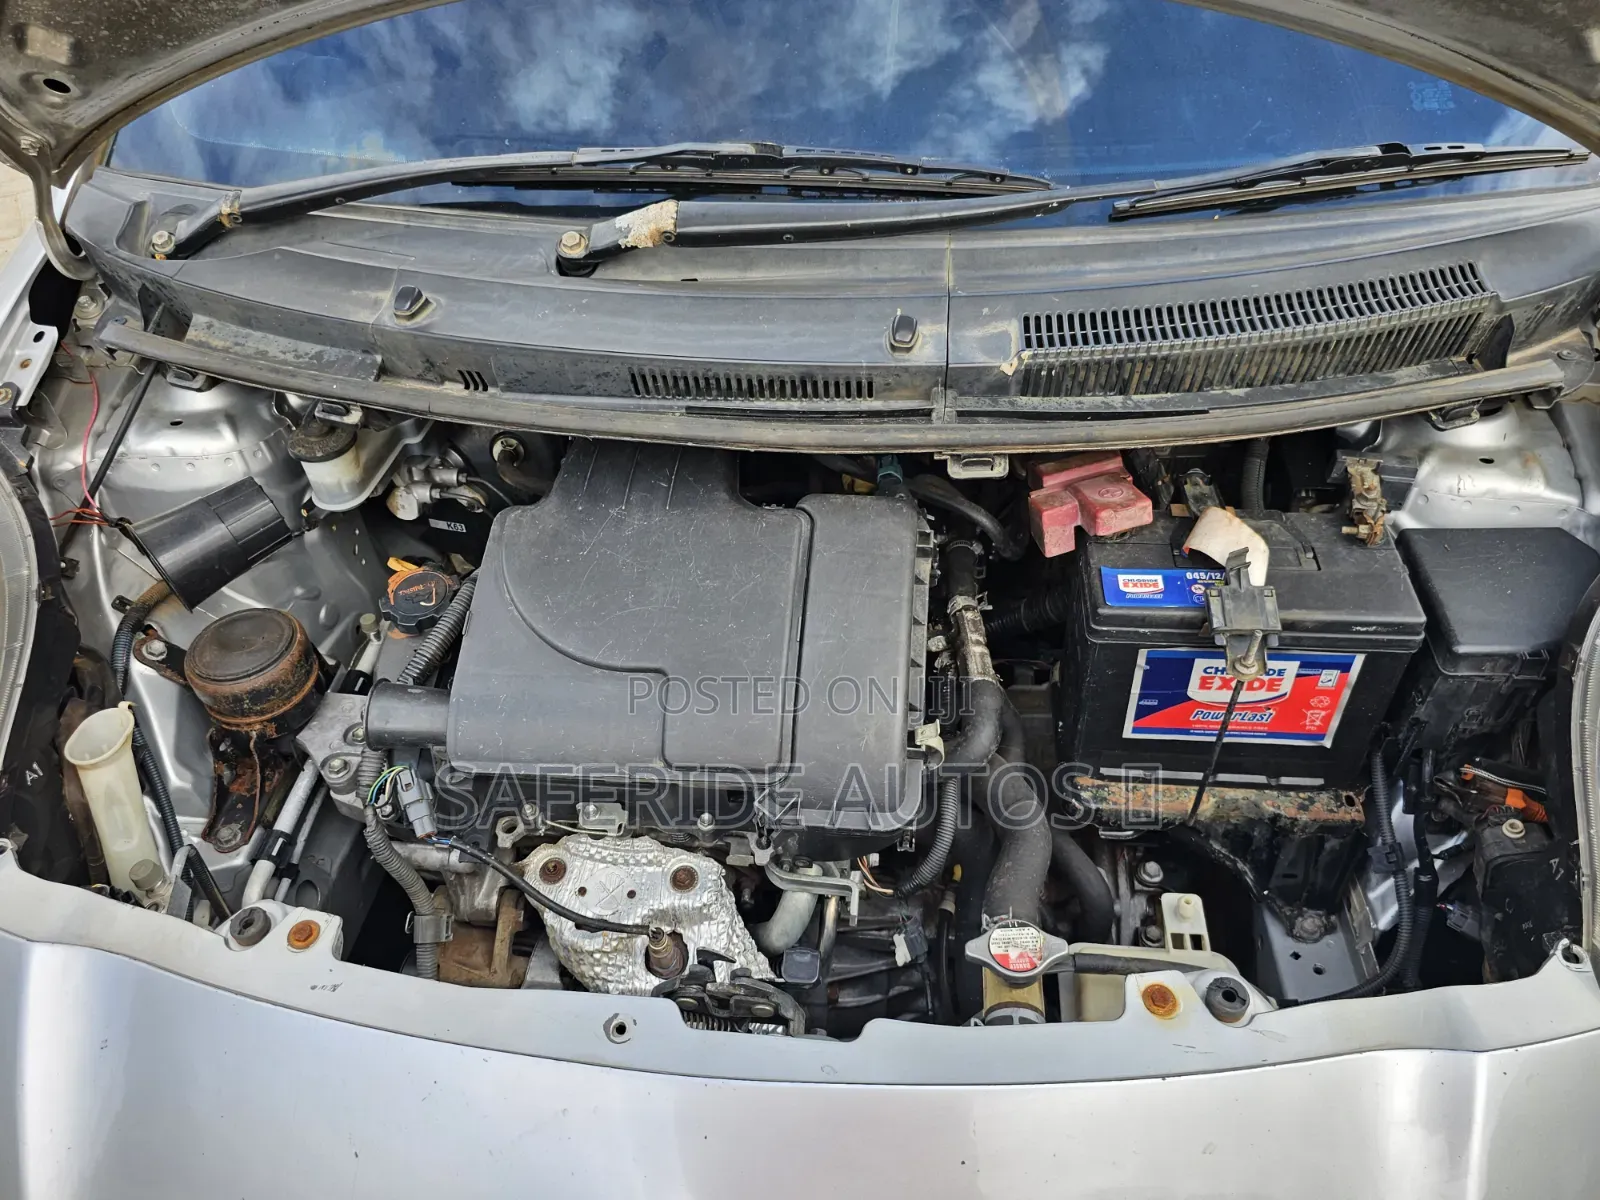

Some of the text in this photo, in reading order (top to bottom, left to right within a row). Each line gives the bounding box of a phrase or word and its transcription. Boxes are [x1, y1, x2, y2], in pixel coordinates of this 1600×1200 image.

[446, 521, 465, 532] K63
[1202, 666, 1287, 677] CHDE
[1198, 675, 1285, 692] EXDE
[1190, 709, 1276, 723] PowrLast
[25, 761, 43, 786] A1
